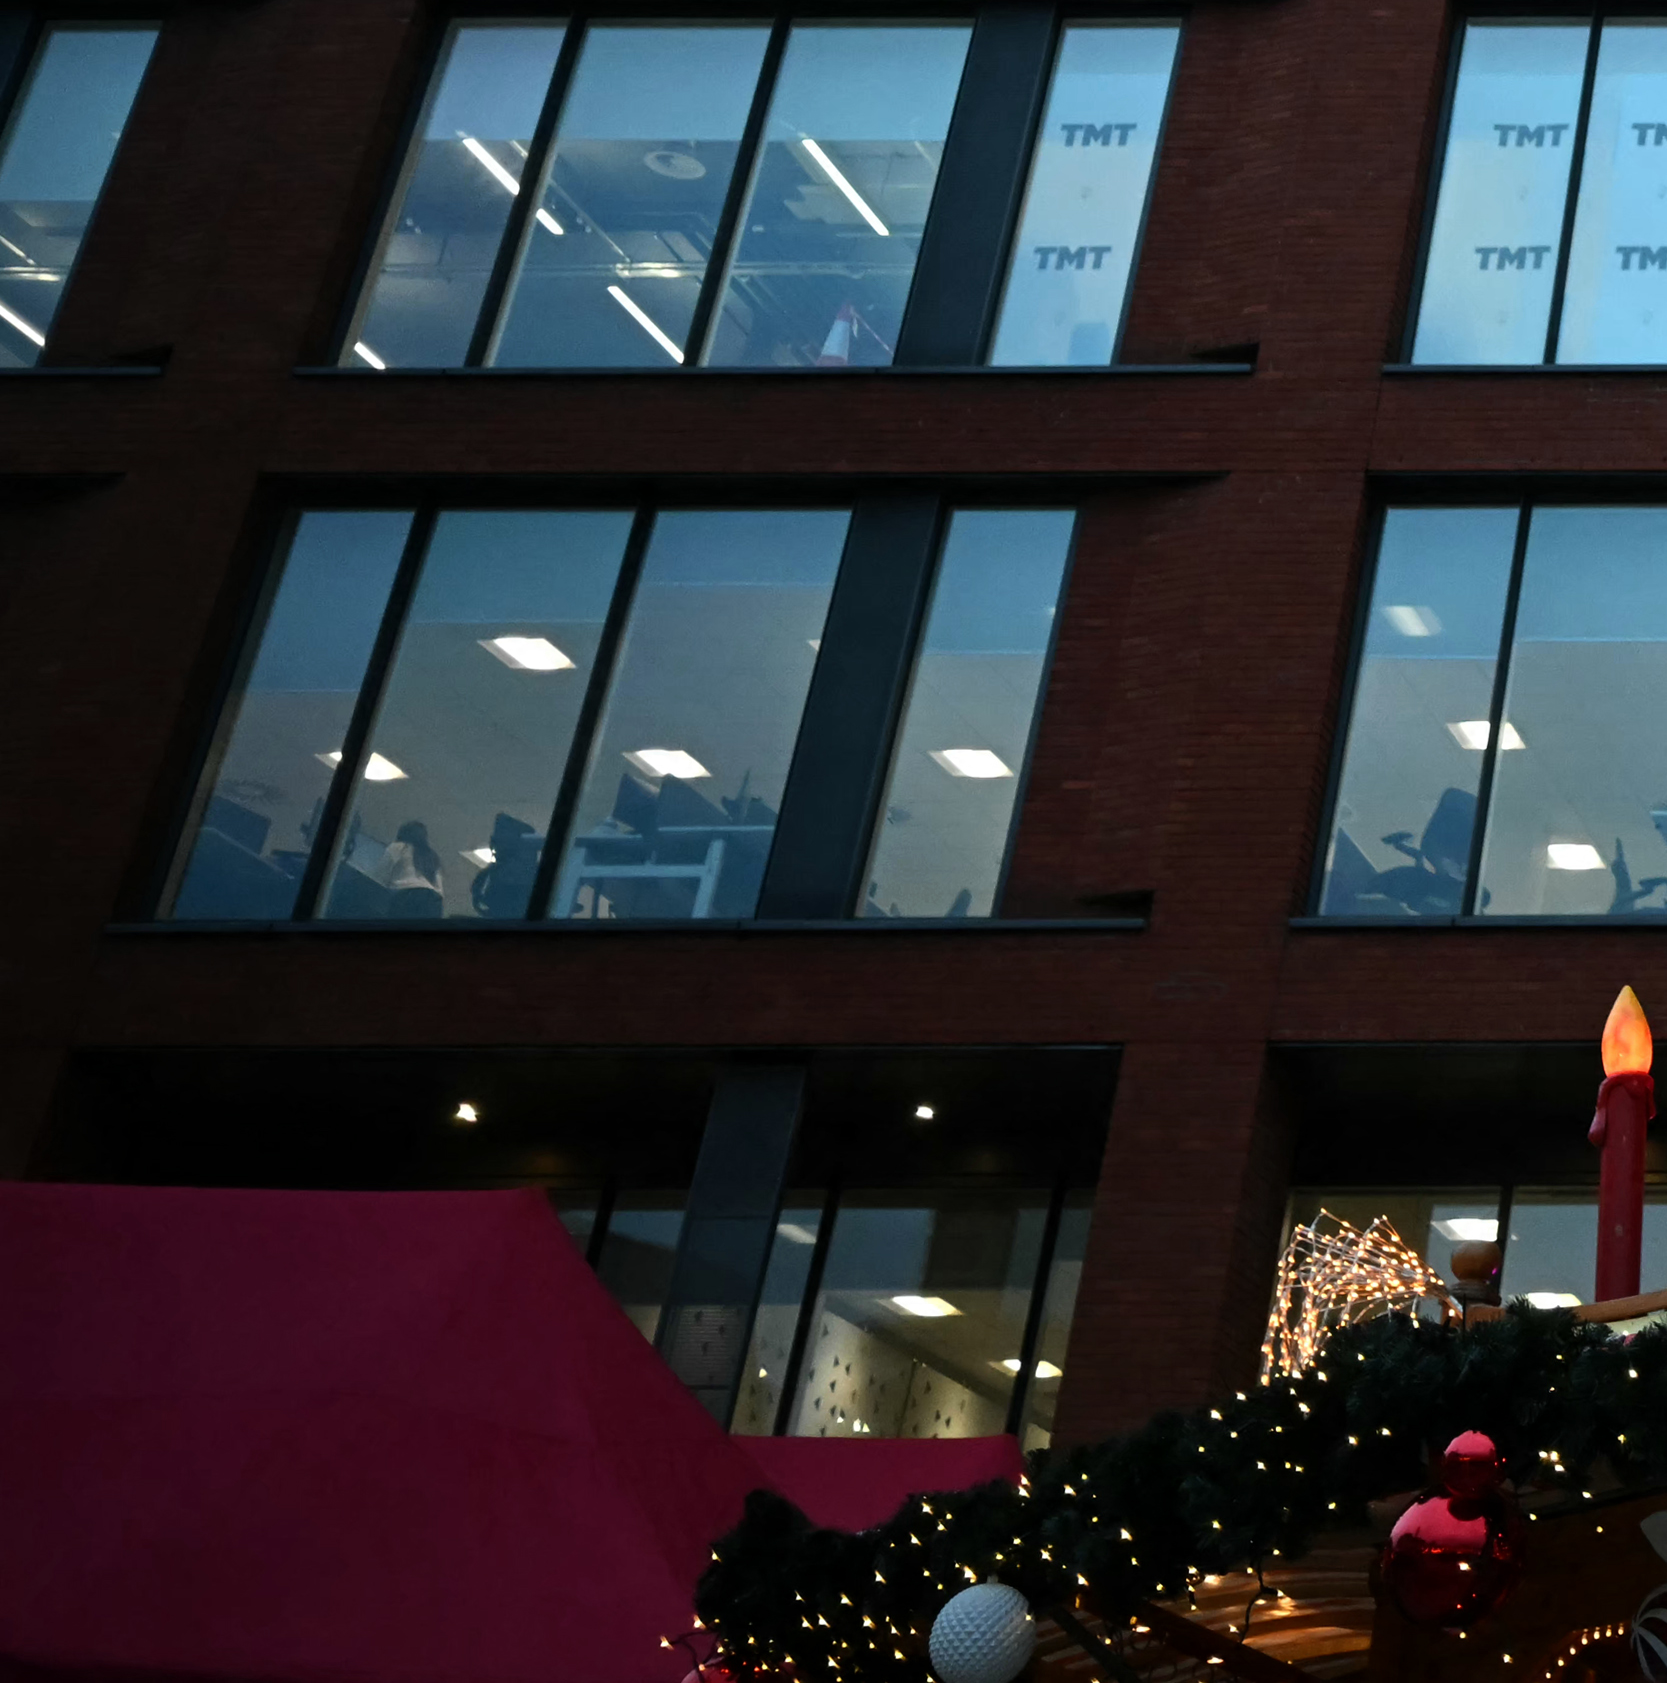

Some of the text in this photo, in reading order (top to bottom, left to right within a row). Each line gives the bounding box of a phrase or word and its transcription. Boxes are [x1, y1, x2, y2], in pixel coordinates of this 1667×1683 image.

[1060, 122, 1137, 147] TMT
[1494, 123, 1569, 148] TMT
[1034, 246, 1111, 271] TMT
[1475, 245, 1551, 271] TMT
